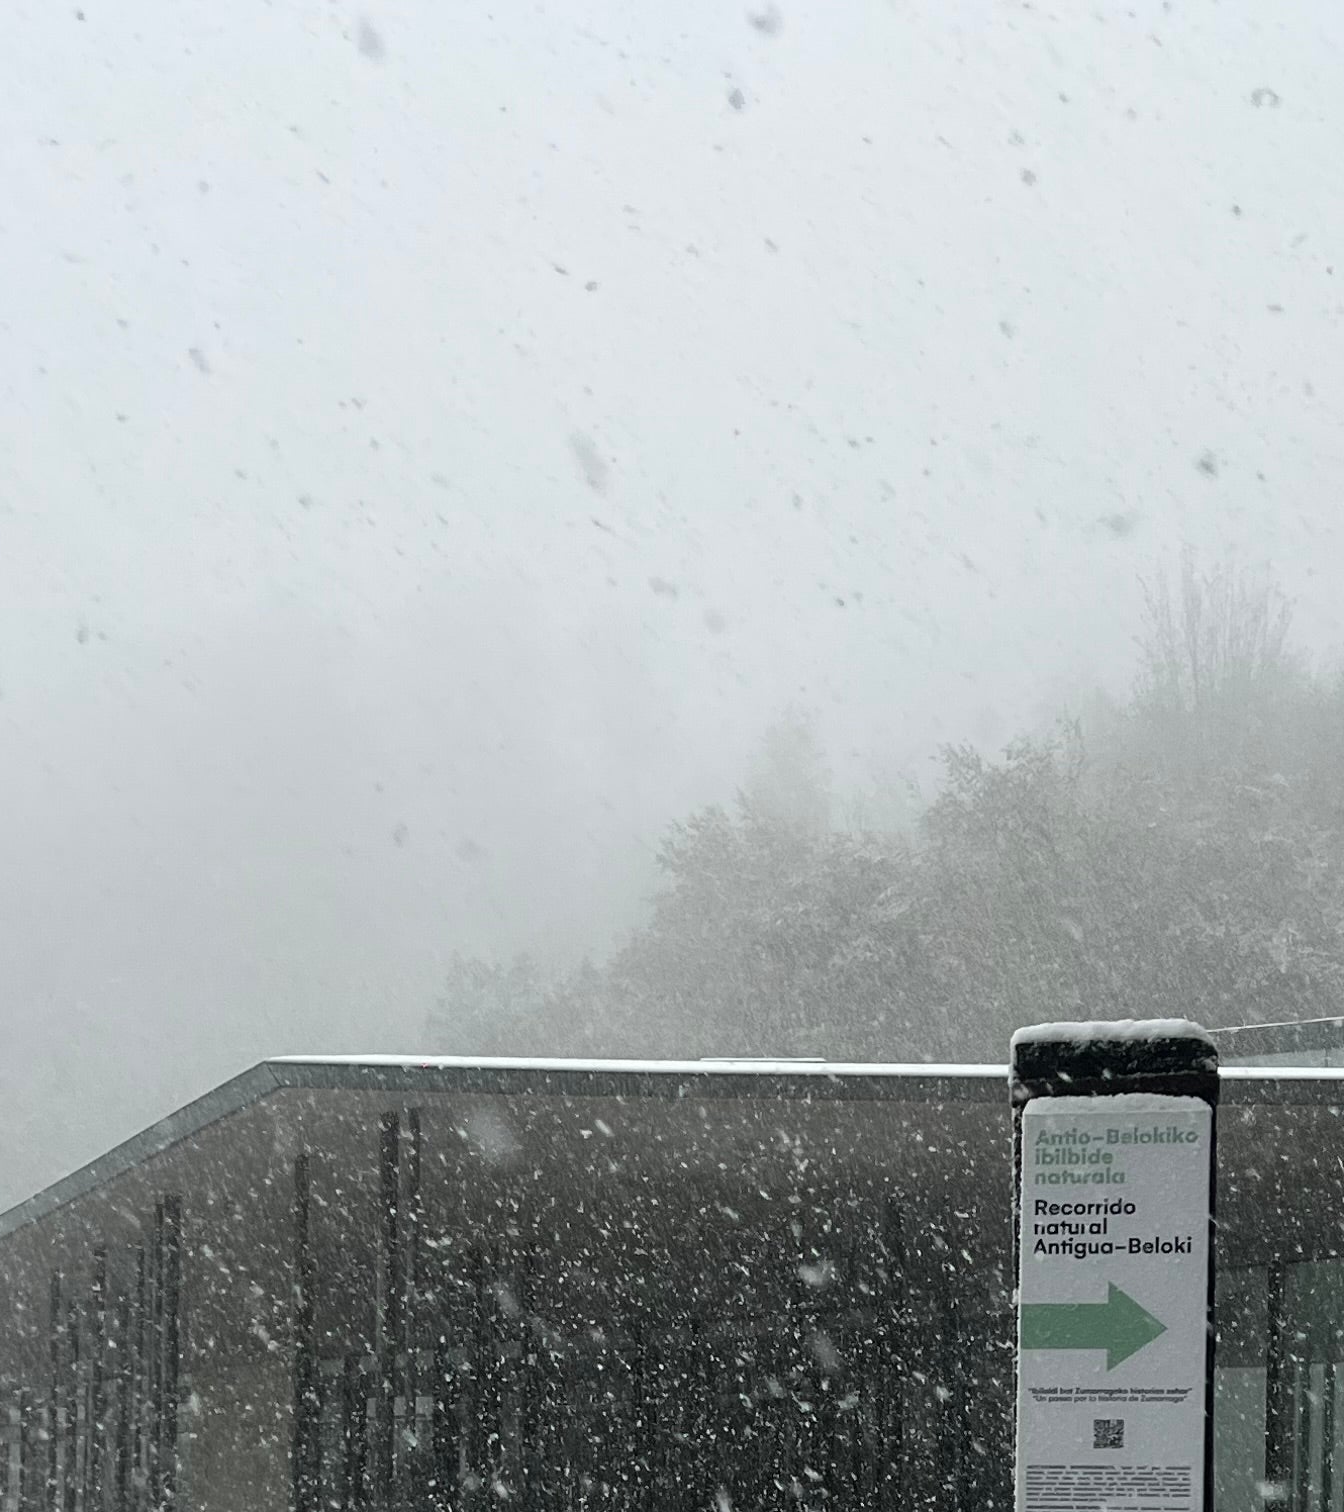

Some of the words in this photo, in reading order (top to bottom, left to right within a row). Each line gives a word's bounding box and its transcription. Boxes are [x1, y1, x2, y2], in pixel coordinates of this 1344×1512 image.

[1035, 1127, 1199, 1146] Antio-Belokiko
[1034, 1148, 1114, 1166] ibilbide
[1034, 1167, 1126, 1185] naturala
[1034, 1198, 1136, 1216] Recorrido
[1034, 1217, 1108, 1235] natural
[1033, 1236, 1193, 1260] Antigua-Beloki
